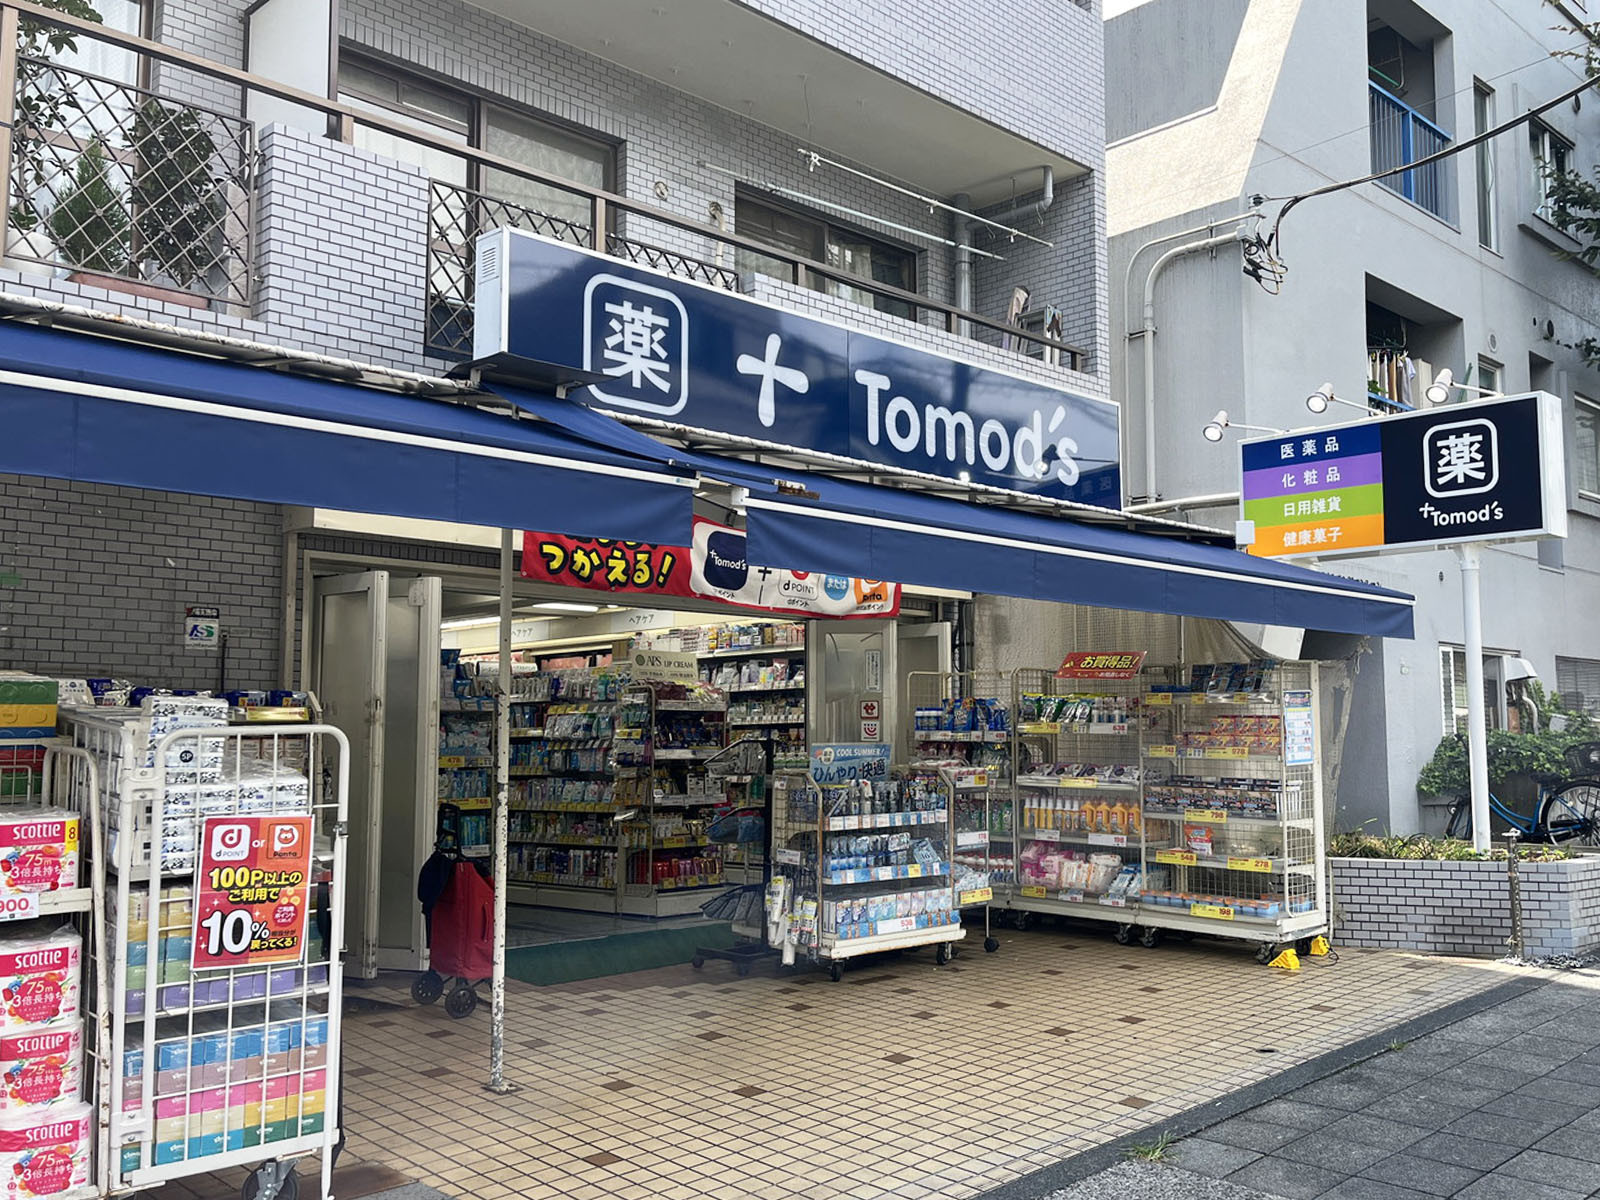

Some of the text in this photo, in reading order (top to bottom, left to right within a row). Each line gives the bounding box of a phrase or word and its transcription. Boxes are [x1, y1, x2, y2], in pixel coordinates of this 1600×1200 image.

[602, 301, 671, 394] 薬
[854, 369, 1080, 487] Tomod's
[1280, 436, 1339, 460] 医薬品
[1436, 432, 1486, 486] 薬
[1282, 466, 1340, 488] 化粧品
[1284, 496, 1341, 517] 日用雑貨
[1283, 526, 1342, 547] 健康菓子
[629, 614, 654, 624] ヘアケア
[673, 661, 693, 669] CREAM
[836, 749, 853, 757] COOL
[68, 826, 76, 839] 8
[252, 840, 266, 848] or
[209, 866, 302, 889] 100P以上の
[228, 887, 280, 902] ご利用で
[202, 909, 269, 955] 10%
[250, 936, 298, 950] 戻ってくる!
[71, 949, 78, 960] 4
